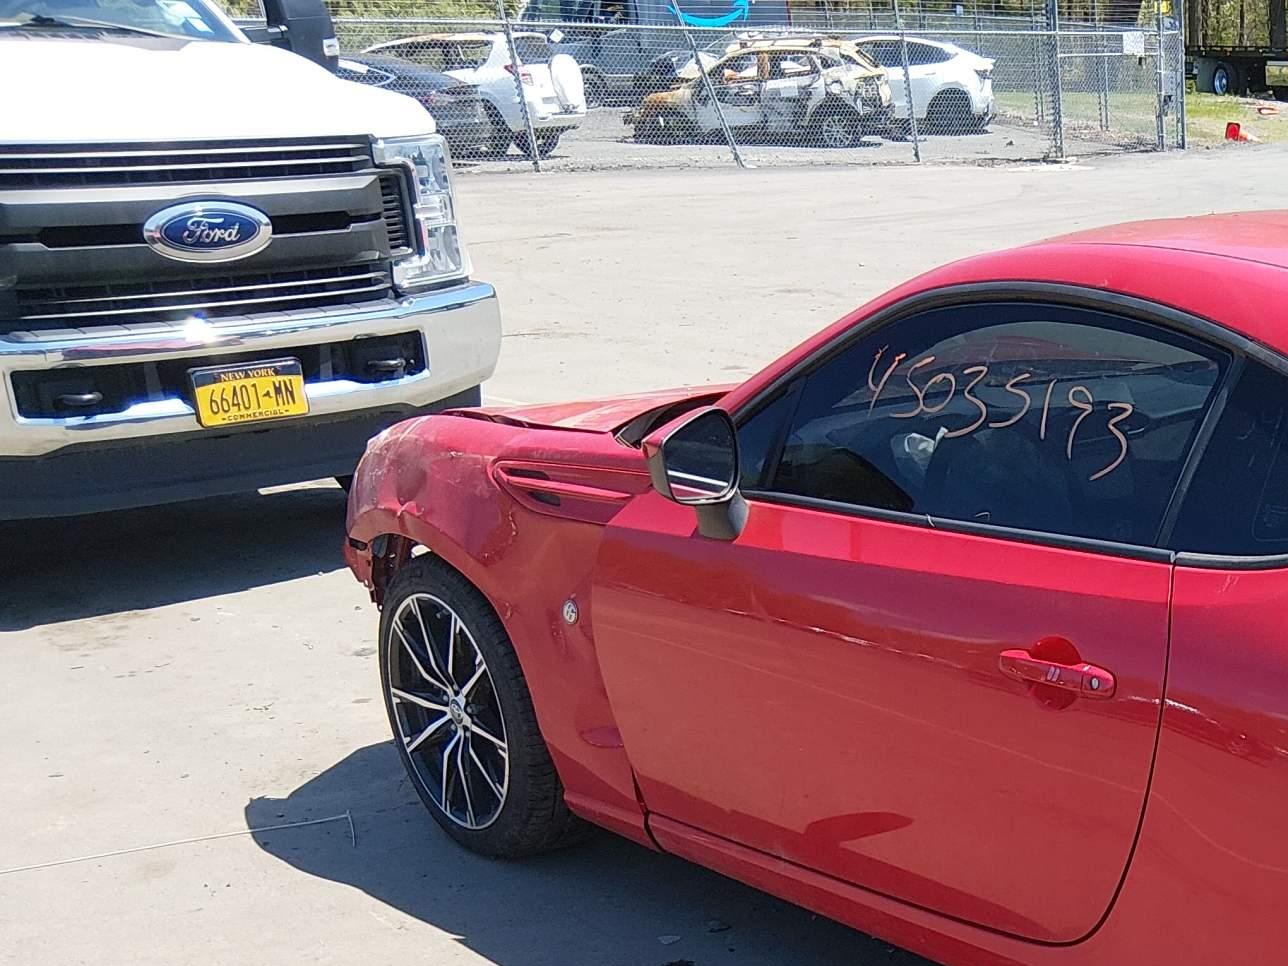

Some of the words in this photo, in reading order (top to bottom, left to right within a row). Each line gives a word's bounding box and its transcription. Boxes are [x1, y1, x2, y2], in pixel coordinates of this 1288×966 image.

[182, 217, 240, 244] Ford
[220, 371, 246, 382] NEW
[249, 367, 276, 378] YORK
[867, 345, 1134, 481] 45035193
